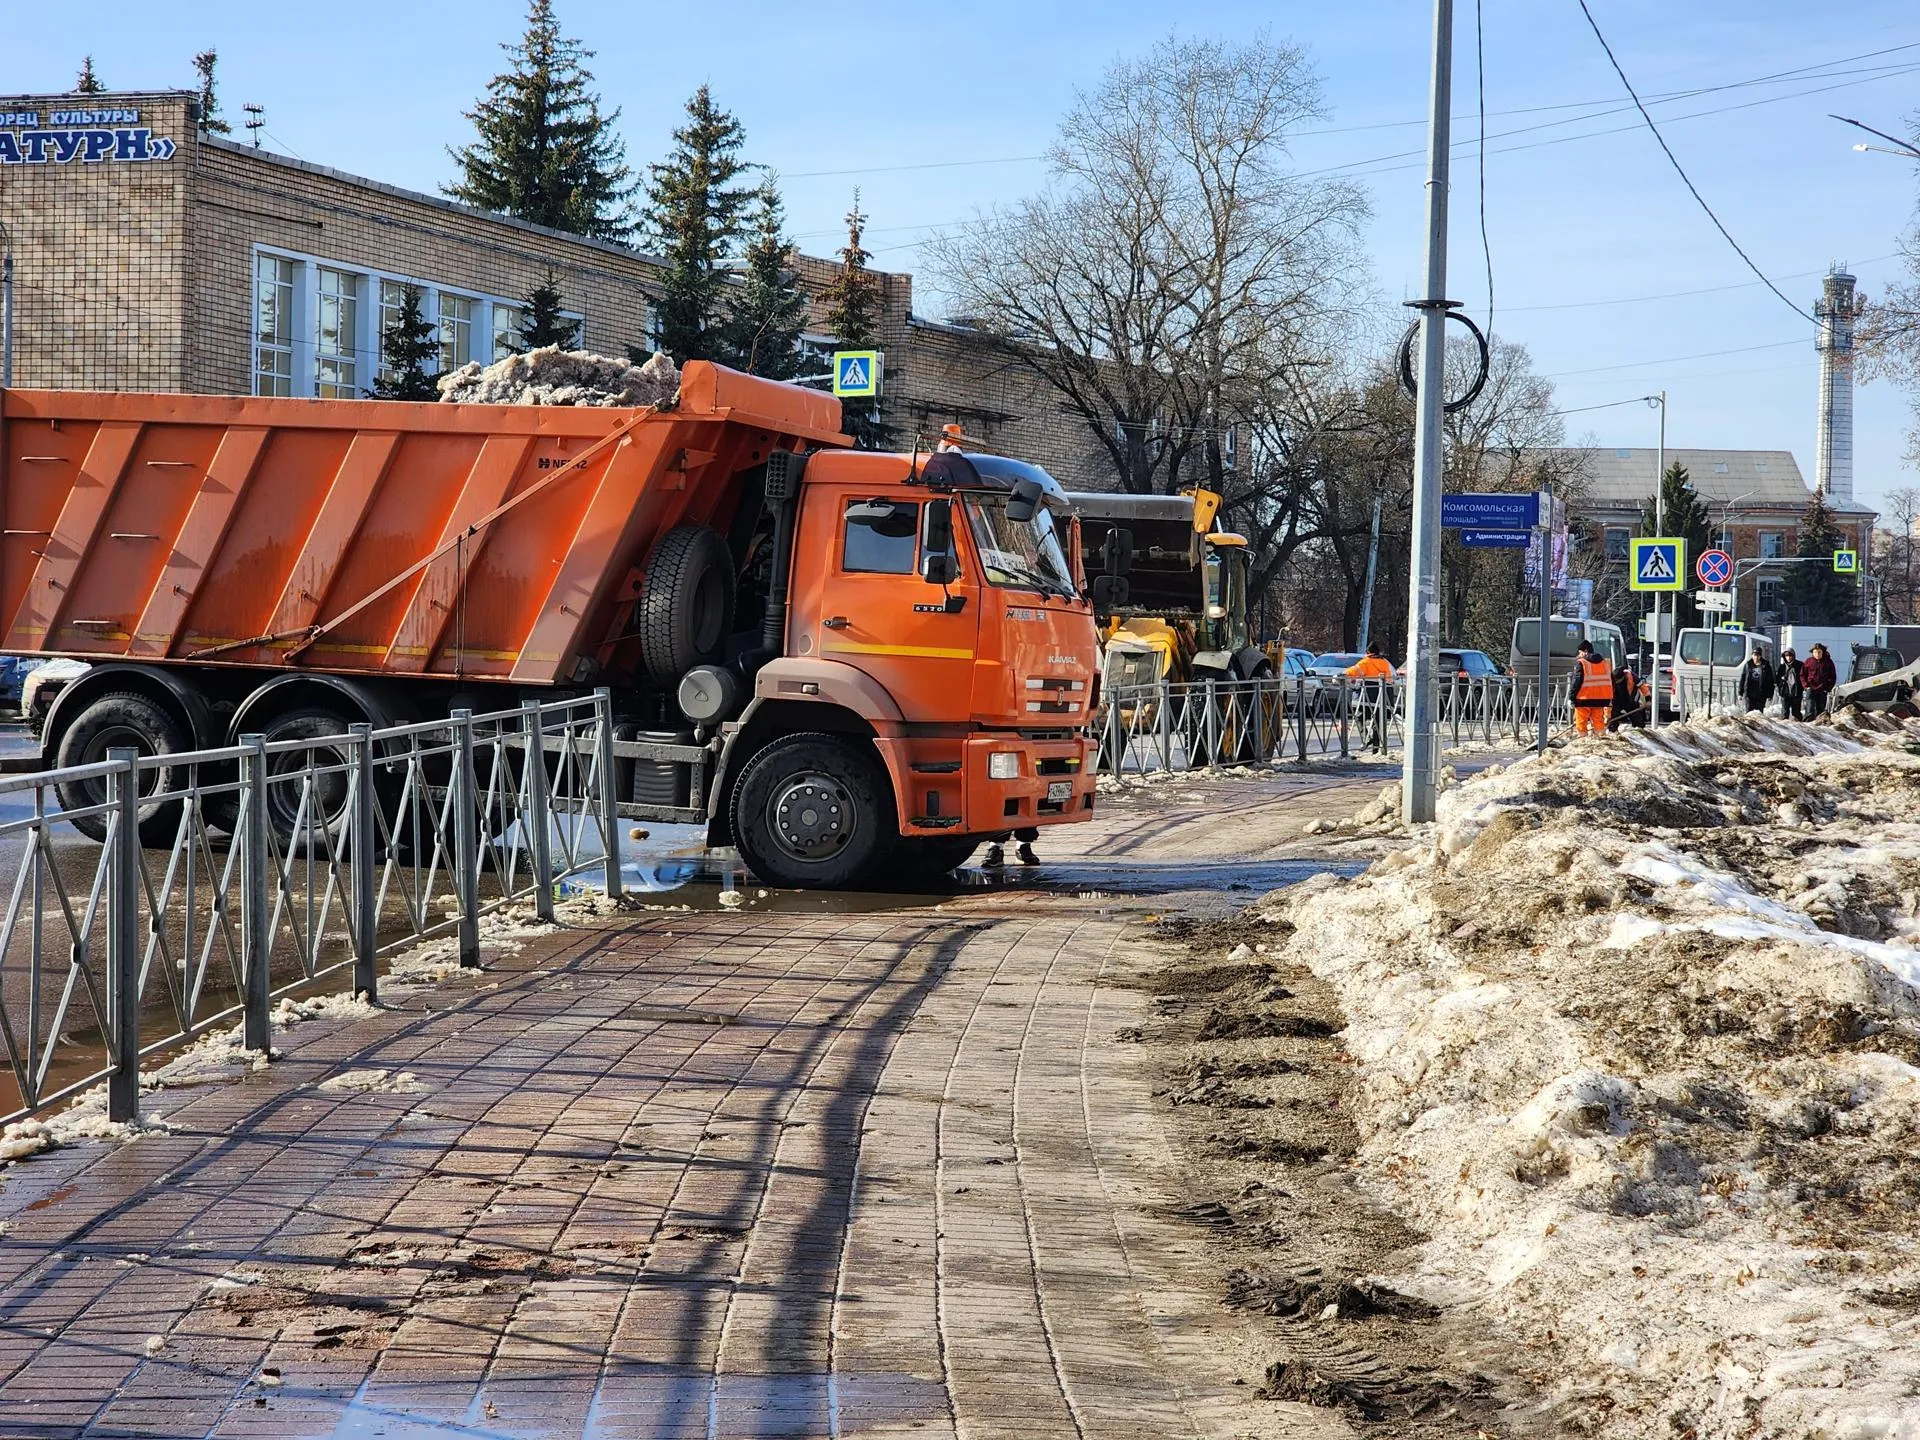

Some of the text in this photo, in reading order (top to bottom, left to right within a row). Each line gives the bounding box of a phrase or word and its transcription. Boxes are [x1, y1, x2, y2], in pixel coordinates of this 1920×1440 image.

[50, 109, 139, 125] КУЛЬТУРЫ
[1443, 501, 1525, 513] Комсомольская
[1443, 516, 1478, 524] площадь
[1475, 532, 1527, 542] Администрация
[1048, 655, 1077, 664] KAMAZ
